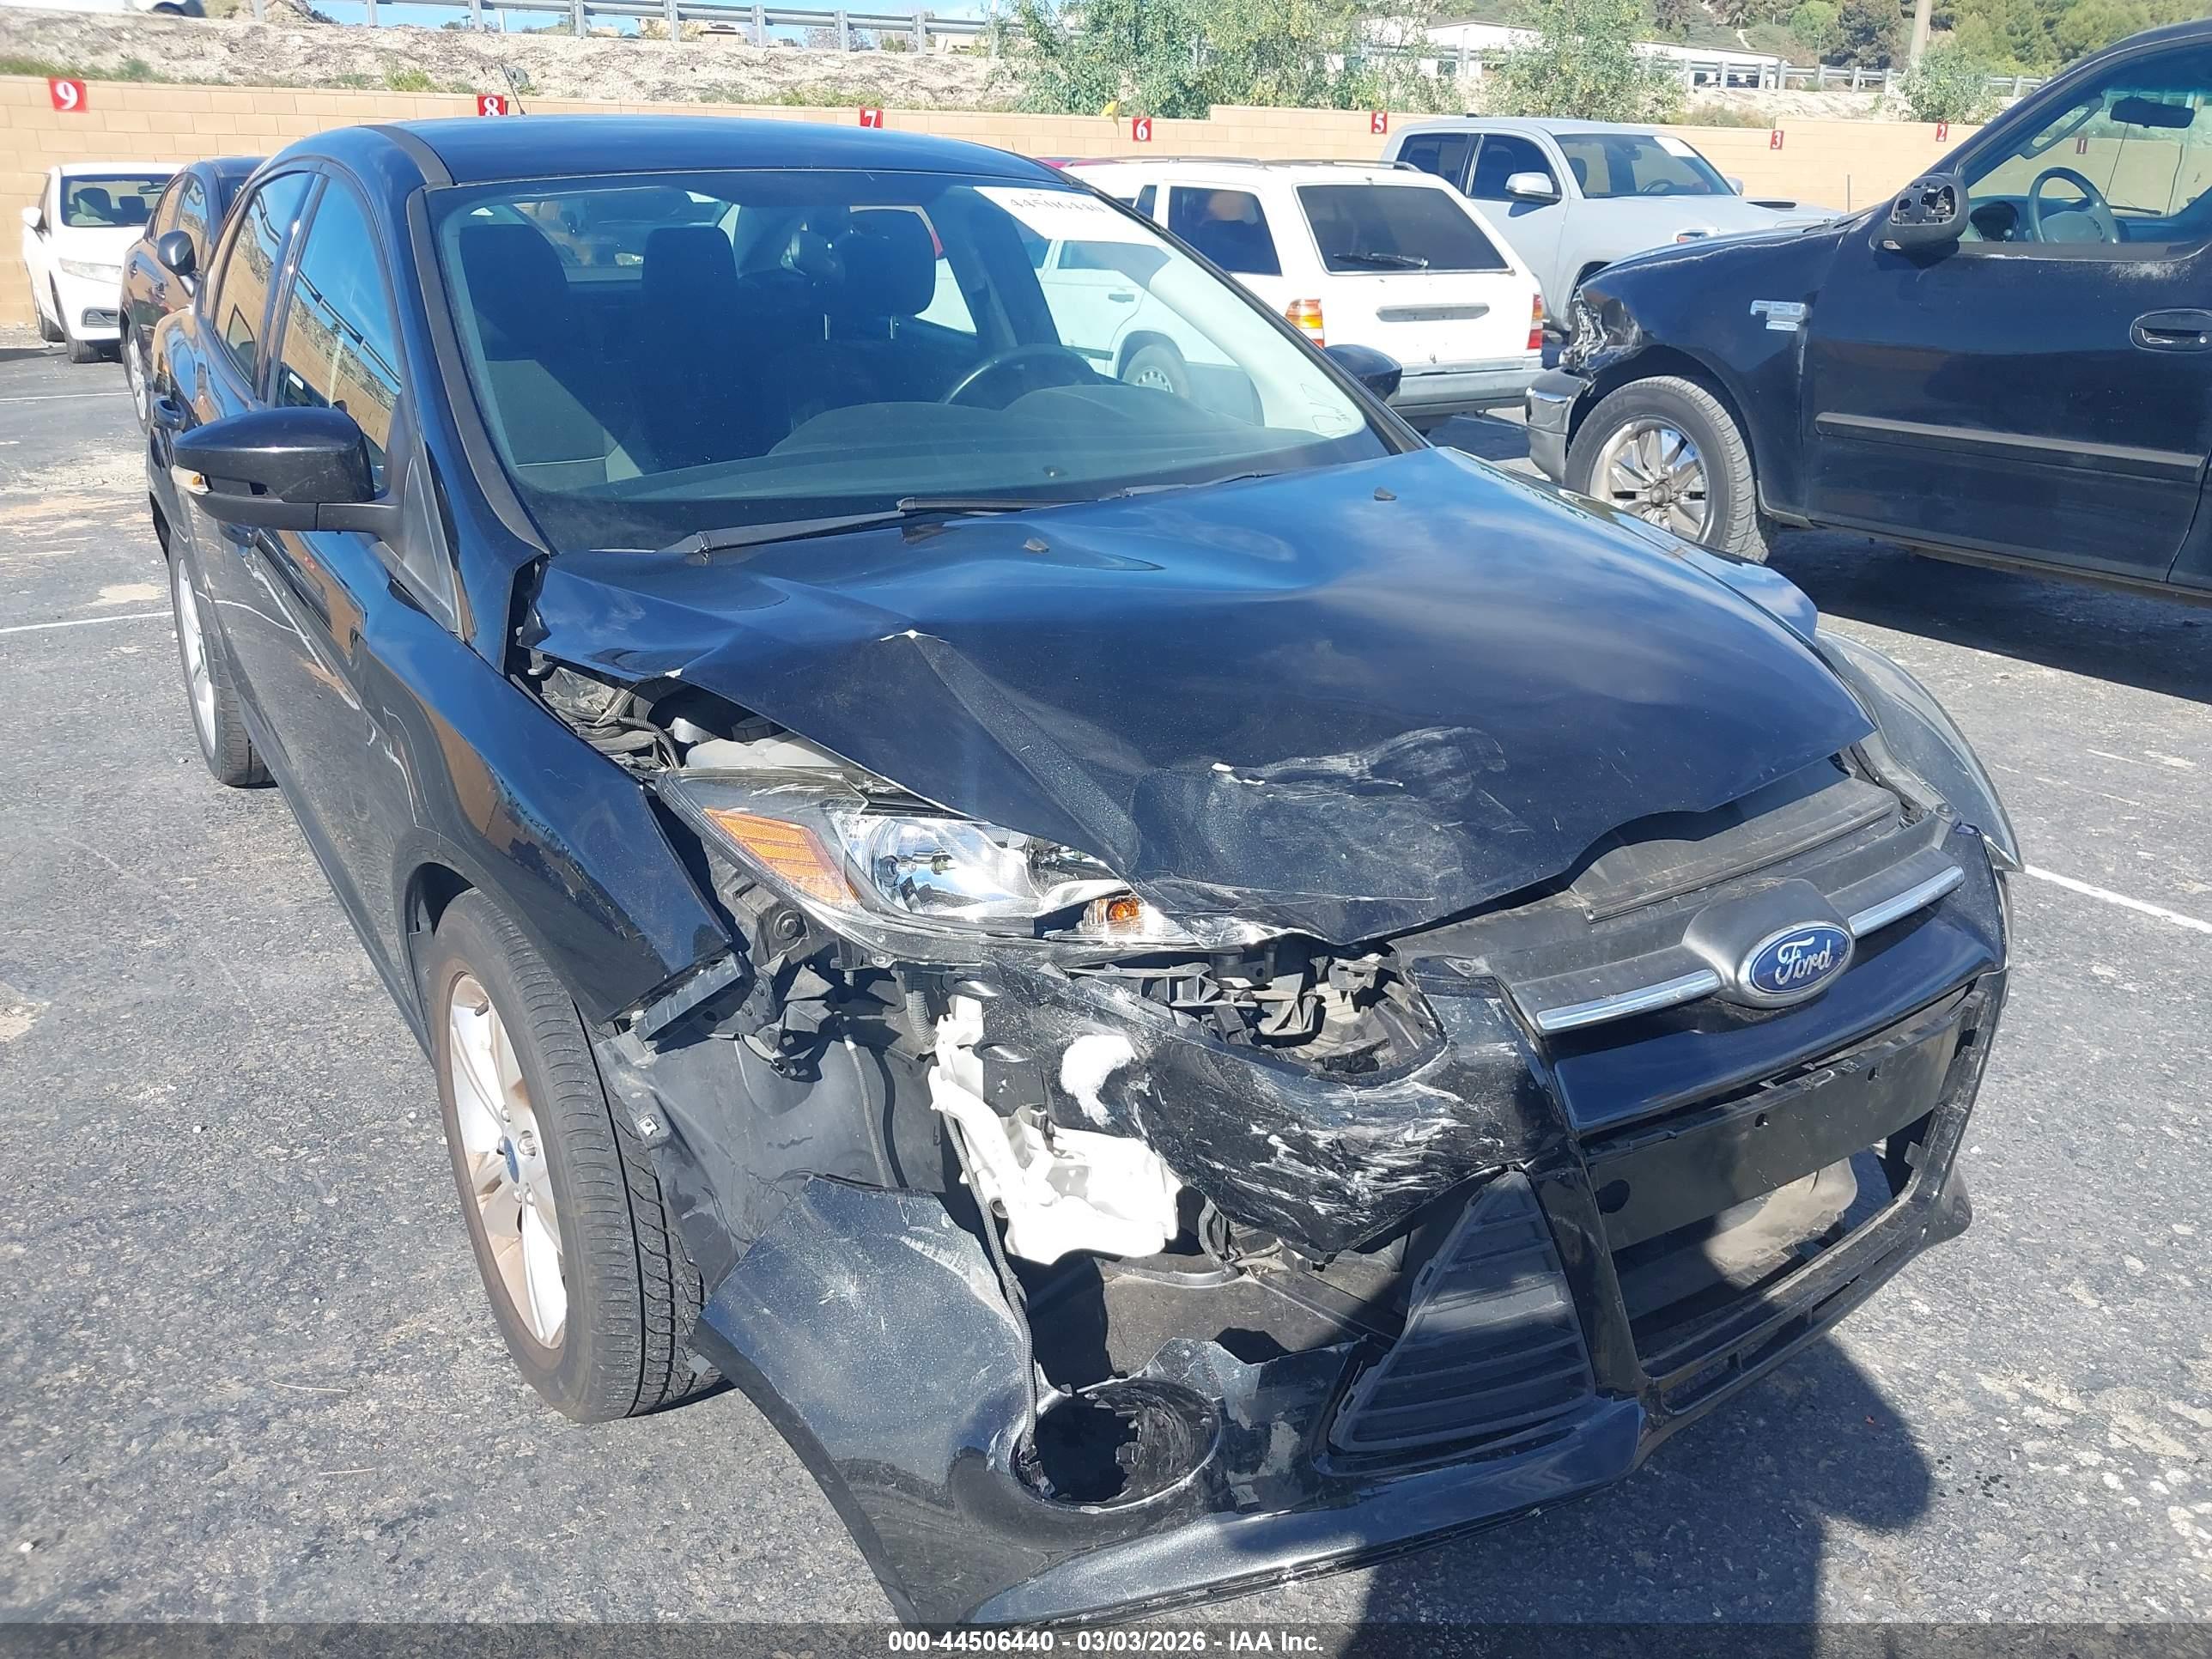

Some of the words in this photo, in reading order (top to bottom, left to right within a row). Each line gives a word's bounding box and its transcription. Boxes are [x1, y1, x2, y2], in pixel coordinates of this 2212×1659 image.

[56, 82, 78, 109] 9
[484, 97, 500, 116] 8
[865, 110, 877, 128] 7
[1374, 113, 1384, 133] 5
[1136, 119, 1148, 140] 6
[1937, 125, 1946, 141] 2
[1772, 131, 1782, 149] 3
[1775, 935, 1832, 985] Ford
